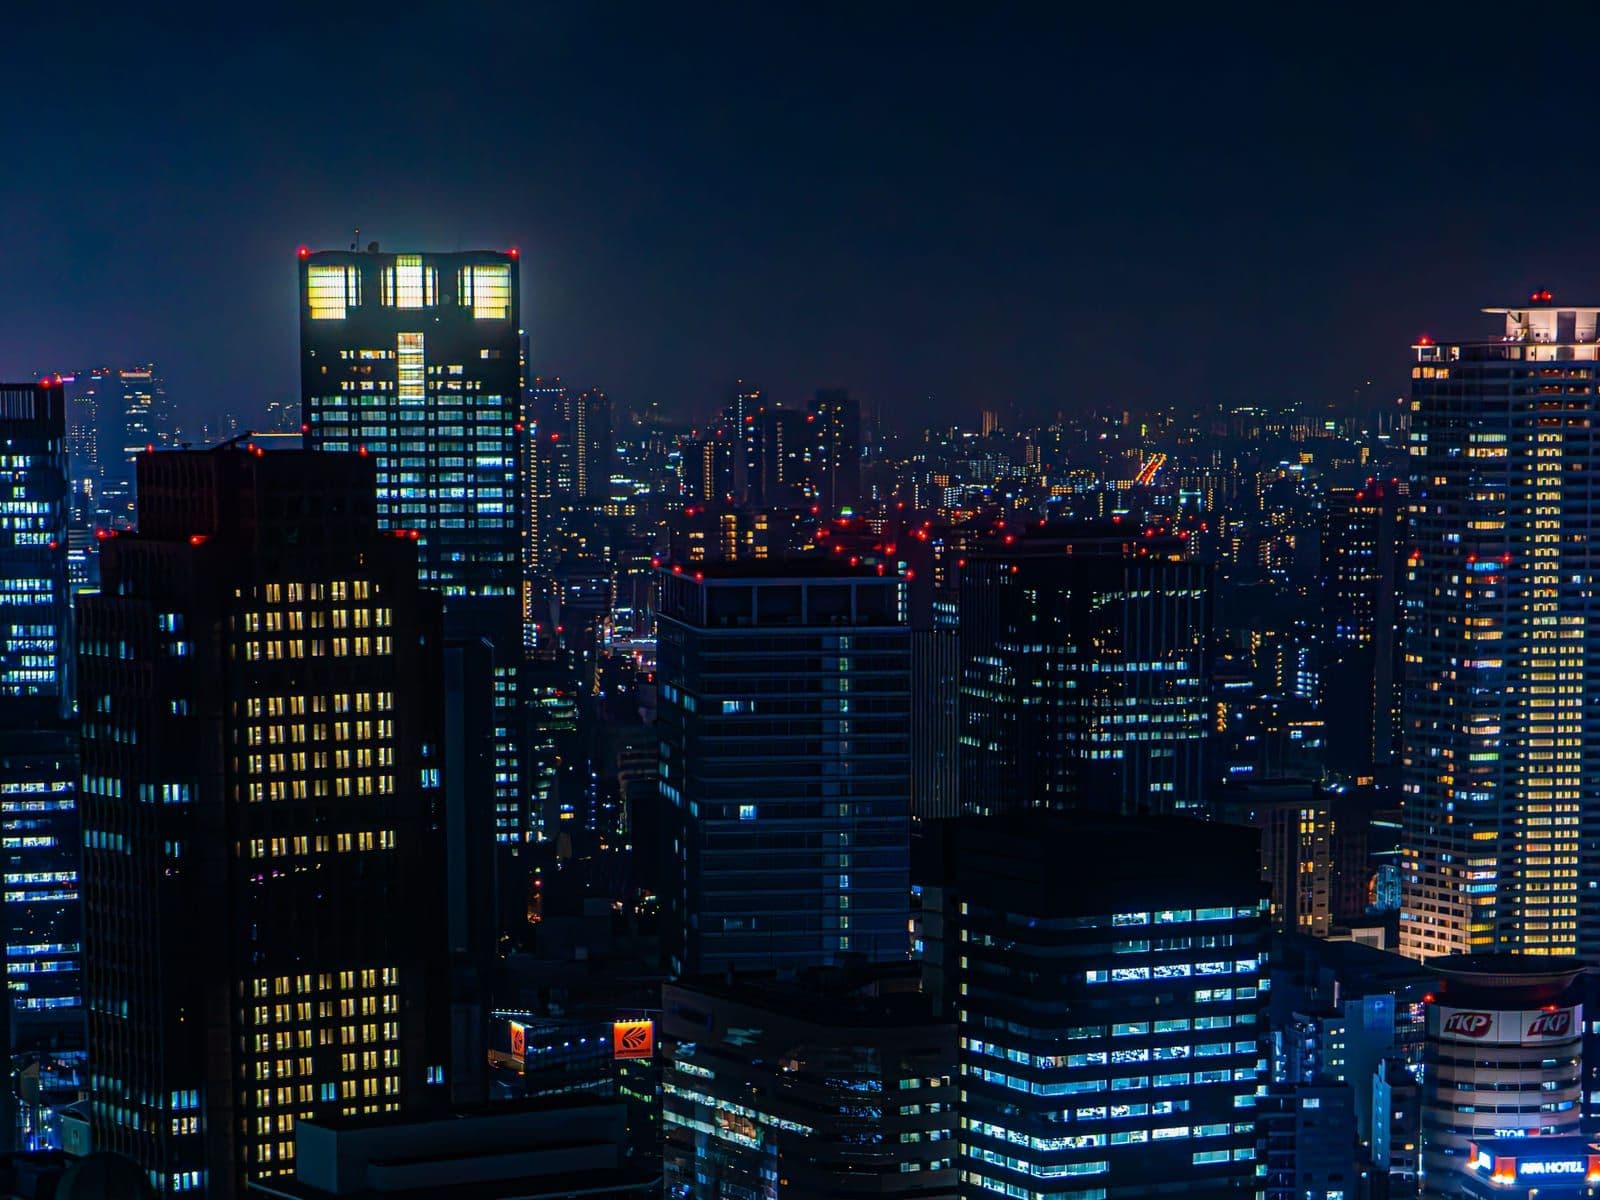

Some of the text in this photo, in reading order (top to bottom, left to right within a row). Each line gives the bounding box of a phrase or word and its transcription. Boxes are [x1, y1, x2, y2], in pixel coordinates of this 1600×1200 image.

[1446, 1014, 1488, 1033] TKP
[1531, 1012, 1568, 1034] TKP
[1520, 1161, 1585, 1174] APA HOTEL
